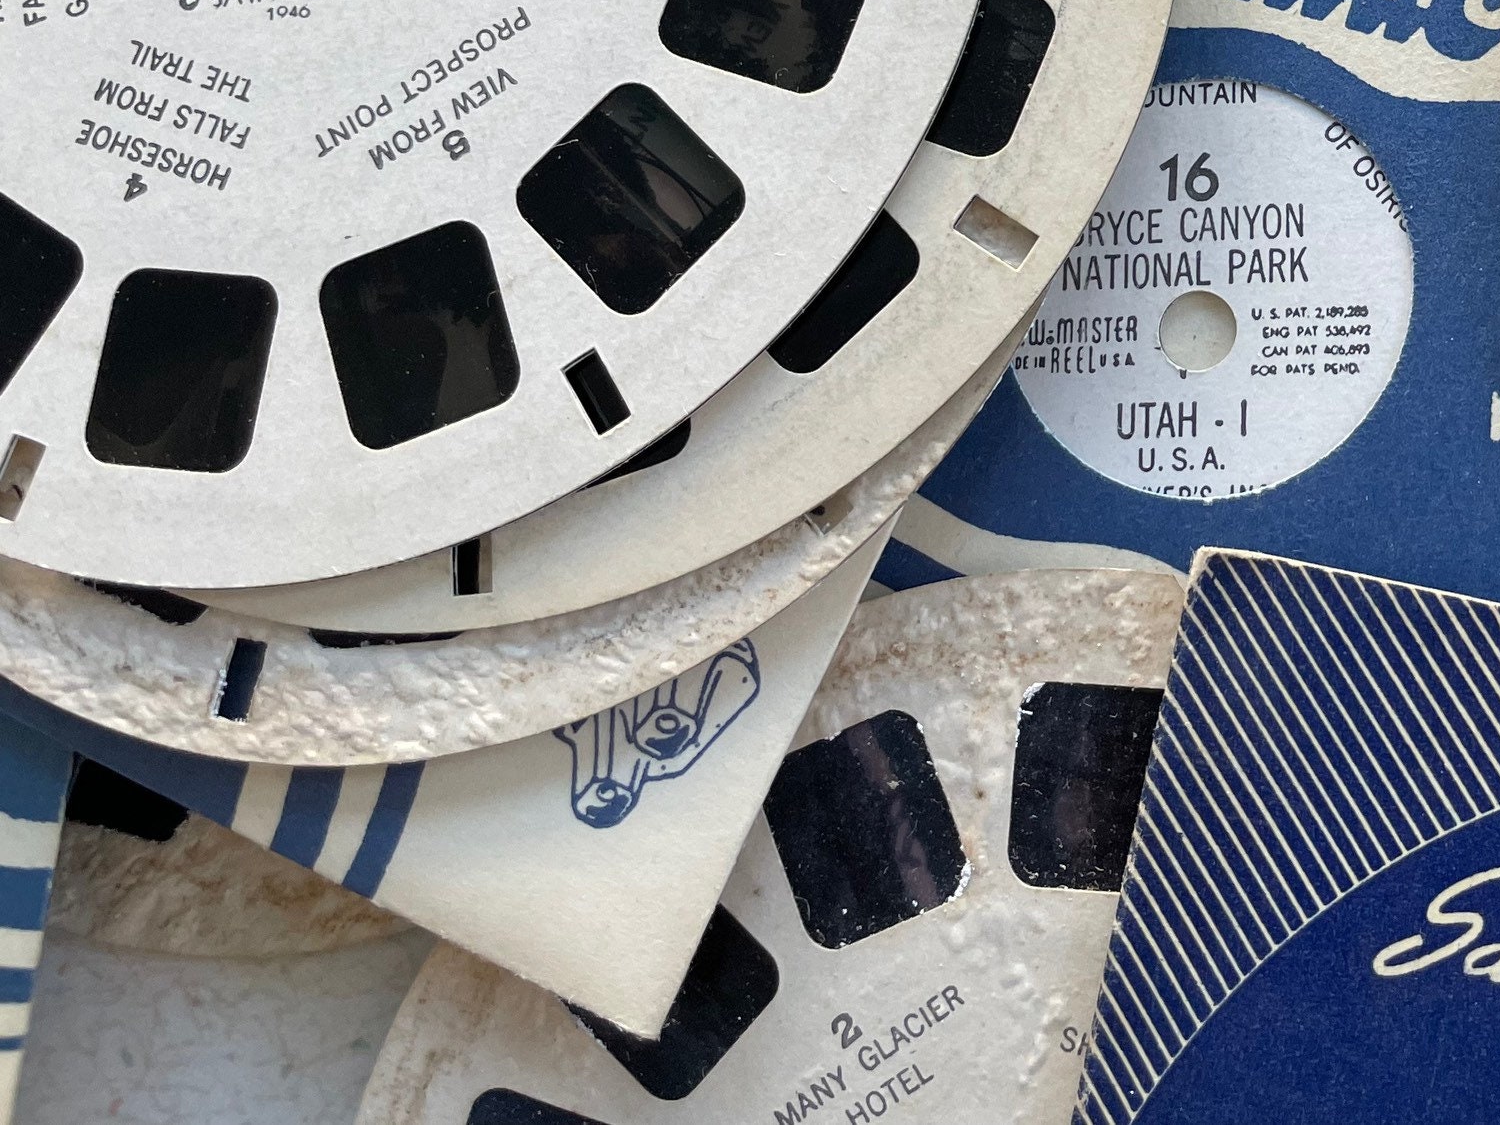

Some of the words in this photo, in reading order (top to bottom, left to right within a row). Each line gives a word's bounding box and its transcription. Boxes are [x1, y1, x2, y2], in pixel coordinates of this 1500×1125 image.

[267, 5, 311, 20] 1946
[130, 39, 195, 84] TRAIL
[401, 6, 532, 104] PROSPECT
[93, 78, 169, 122] FROM
[200, 65, 252, 103] THE
[452, 68, 519, 120] VIEW
[173, 104, 252, 150] FALLS
[315, 94, 393, 158] POINT
[368, 109, 446, 170] FROM
[1324, 121, 1360, 151] OF
[74, 119, 232, 191] HORSESHOE
[1159, 152, 1219, 202] 16
[1180, 203, 1304, 243] CANYON
[1062, 250, 1211, 291] NATIONAL
[1228, 246, 1309, 284] PARK
[1262, 326, 1290, 339] ENG
[1297, 325, 1318, 336] PAT
[1262, 346, 1288, 357] CAN
[1295, 345, 1317, 355] PAT
[1050, 346, 1096, 374] REEL
[1250, 364, 1277, 376] FOR
[1286, 363, 1315, 375] PATS
[1117, 401, 1197, 439] UTAH
[831, 1012, 862, 1049] 2
[774, 1065, 847, 1125] MANY
[858, 985, 965, 1071] GLACIER
[845, 1063, 934, 1125] HOTEL
